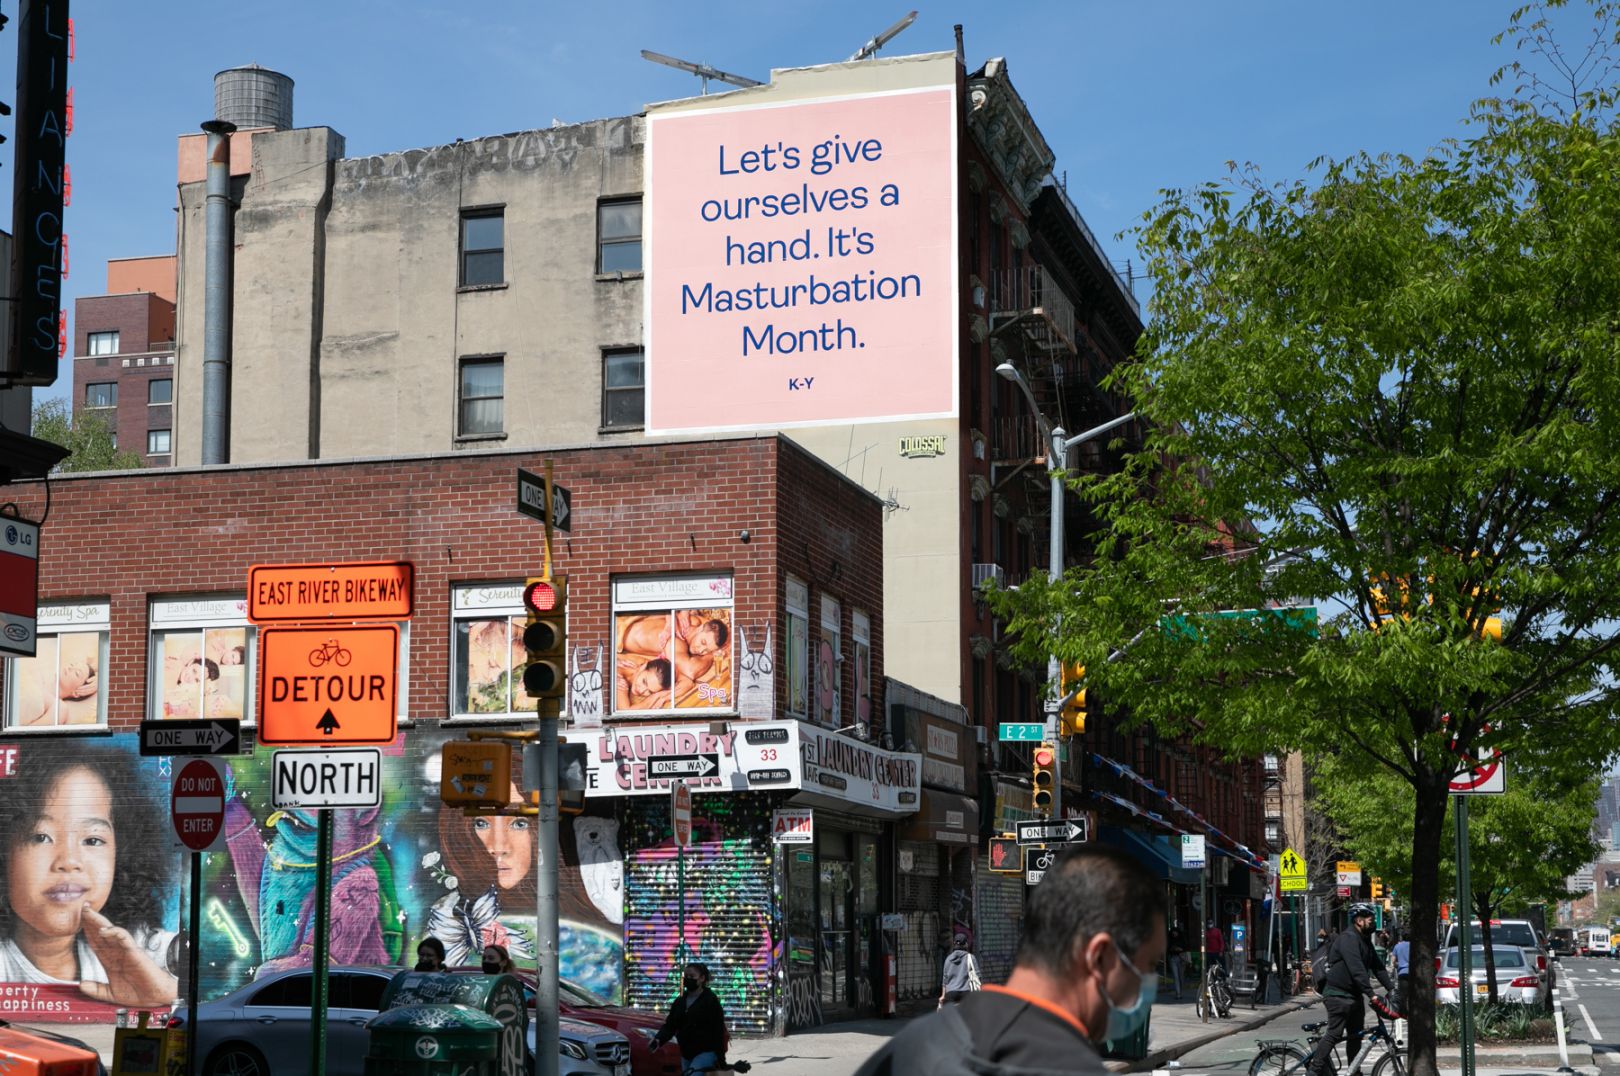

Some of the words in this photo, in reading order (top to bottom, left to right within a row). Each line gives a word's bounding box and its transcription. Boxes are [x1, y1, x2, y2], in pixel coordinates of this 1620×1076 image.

[718, 141, 801, 176] Let's
[810, 134, 883, 175] give
[700, 182, 869, 222] ourselves
[879, 182, 900, 207] a
[725, 228, 820, 266] hand.
[827, 226, 875, 258] It's
[681, 269, 921, 315] Masturbation
[742, 318, 866, 357] Month.
[788, 377, 815, 391] K-Y
[899, 435, 946, 455] COLOSSAL
[525, 485, 543, 507] ONE
[20, 532, 32, 546] LG
[258, 582, 293, 605] EAST
[298, 580, 340, 604] RIVER
[345, 577, 405, 603] BIKEWAY
[479, 586, 523, 603] Serenit
[632, 582, 656, 594] East
[658, 577, 699, 596] Village
[77, 605, 100, 621] Spa
[168, 602, 188, 614] East
[191, 599, 227, 614] Village
[272, 675, 386, 703] DETOUR
[697, 683, 727, 704] Spa
[154, 731, 182, 745] ONE
[195, 730, 225, 745] WAY
[1006, 726, 1013, 739] E
[1018, 726, 1026, 739] 2
[1031, 726, 1038, 734] ST
[599, 731, 737, 761] LAUNDRY
[760, 749, 777, 761] 33
[657, 762, 678, 772] ONE
[687, 761, 708, 771] WAY
[817, 735, 874, 781] LAUNDRY
[181, 777, 194, 792] DO
[198, 777, 215, 792] NOT
[278, 760, 374, 796] NORTH
[183, 818, 214, 833] ENTER
[775, 816, 811, 833] ATM
[1026, 828, 1046, 838] ONE
[1055, 826, 1076, 836] WAY
[0, 1000, 70, 1012] appiness
